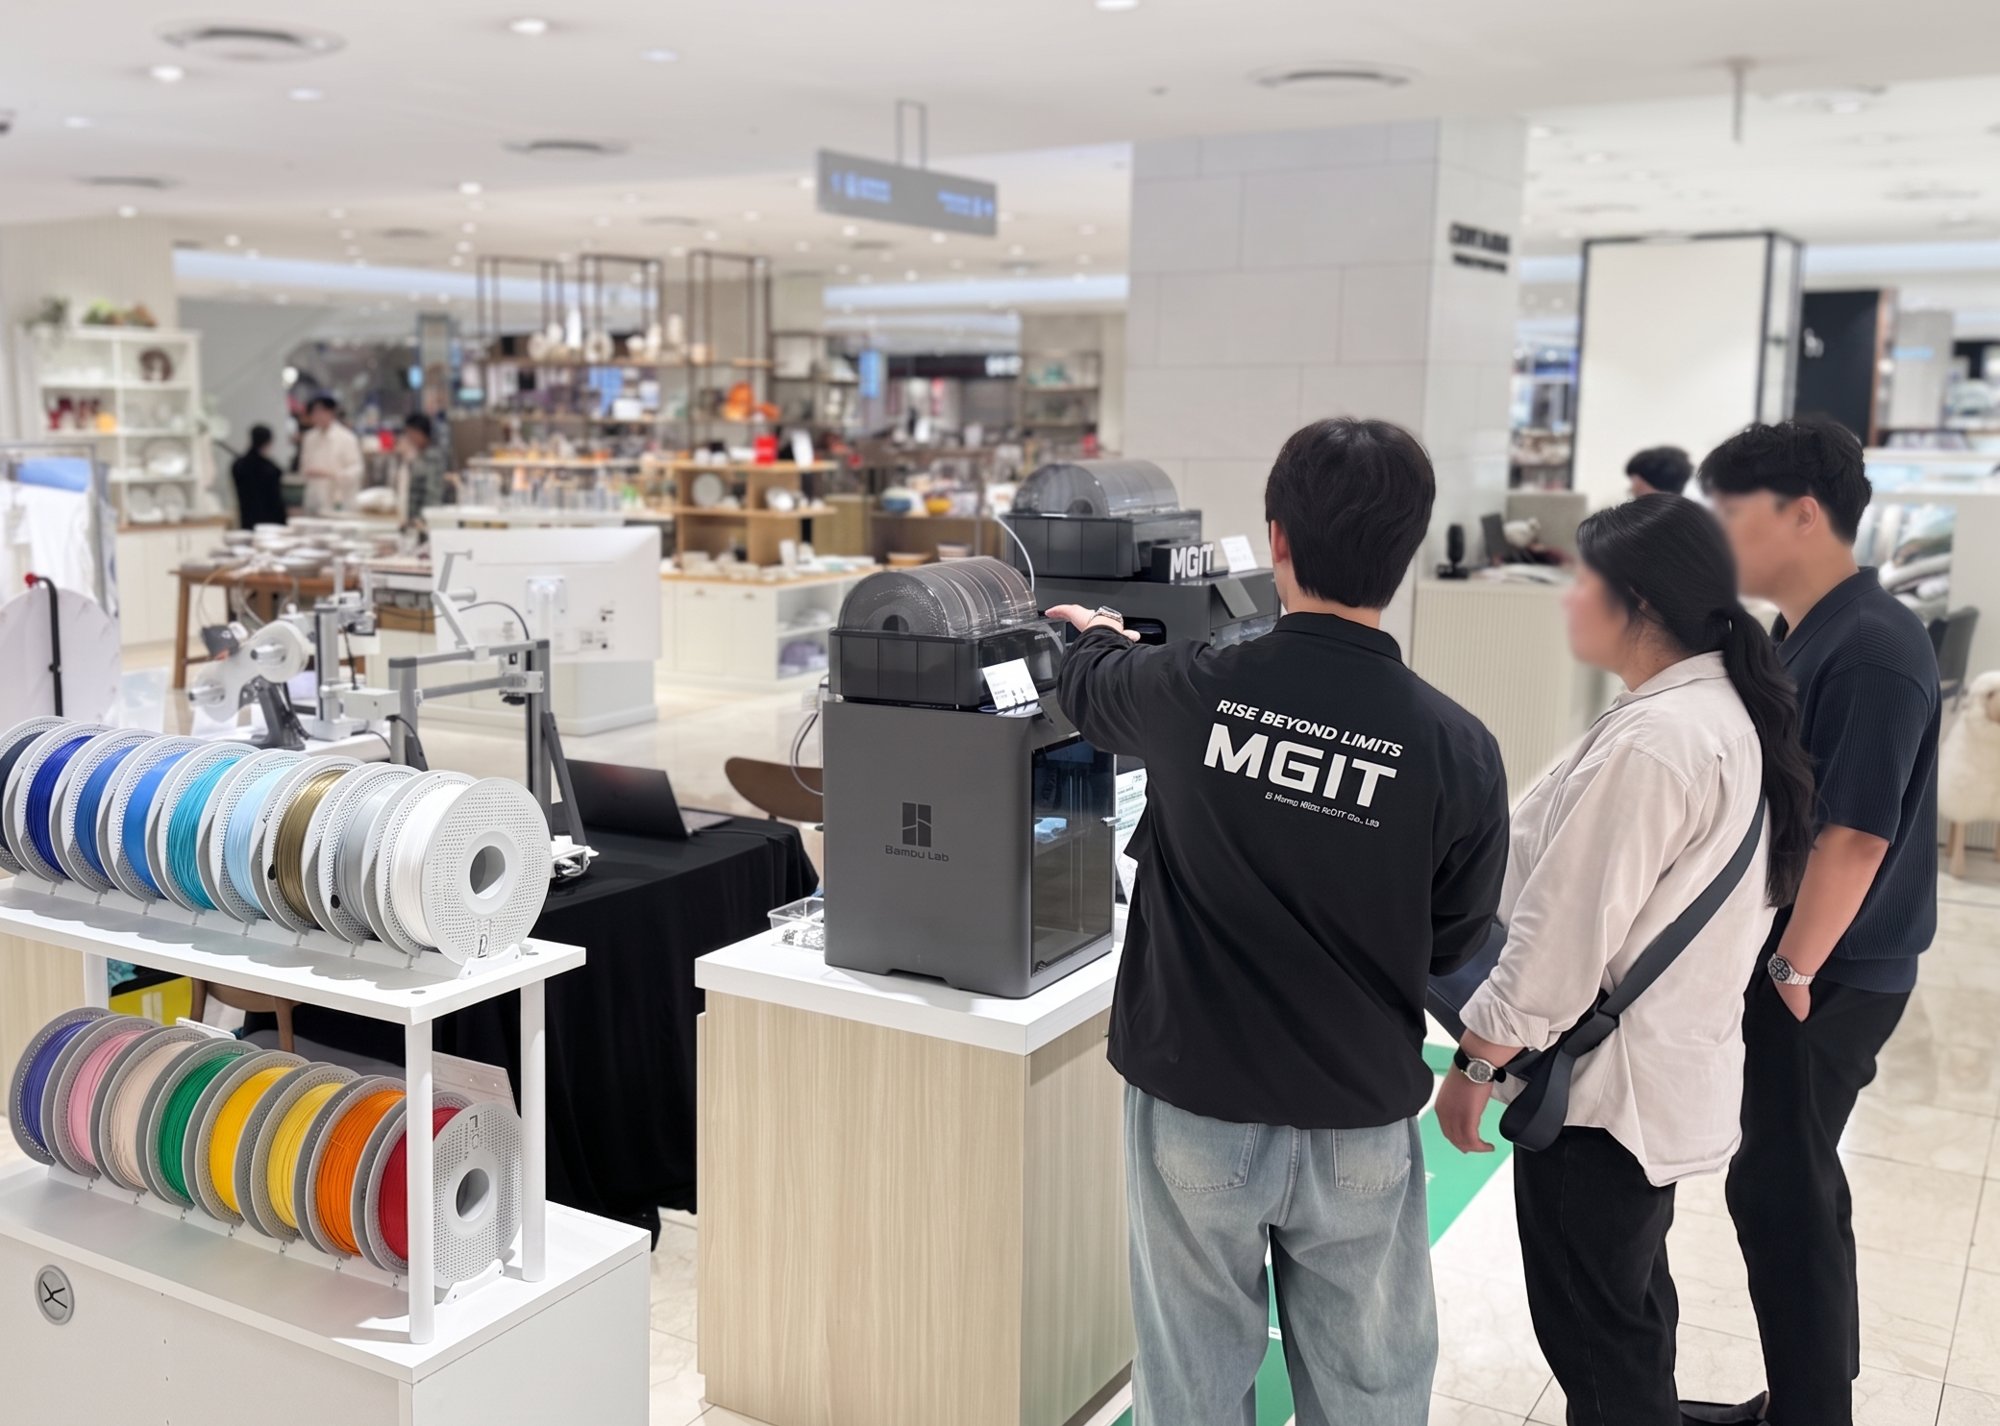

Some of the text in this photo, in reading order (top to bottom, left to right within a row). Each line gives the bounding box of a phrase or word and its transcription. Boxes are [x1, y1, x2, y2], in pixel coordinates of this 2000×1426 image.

[1169, 543, 1214, 581] MGIT
[1216, 699, 1404, 758] RISE BEYOND LIMITS
[1203, 722, 1398, 808] MGIT
[885, 844, 950, 862] Bambu Lab
